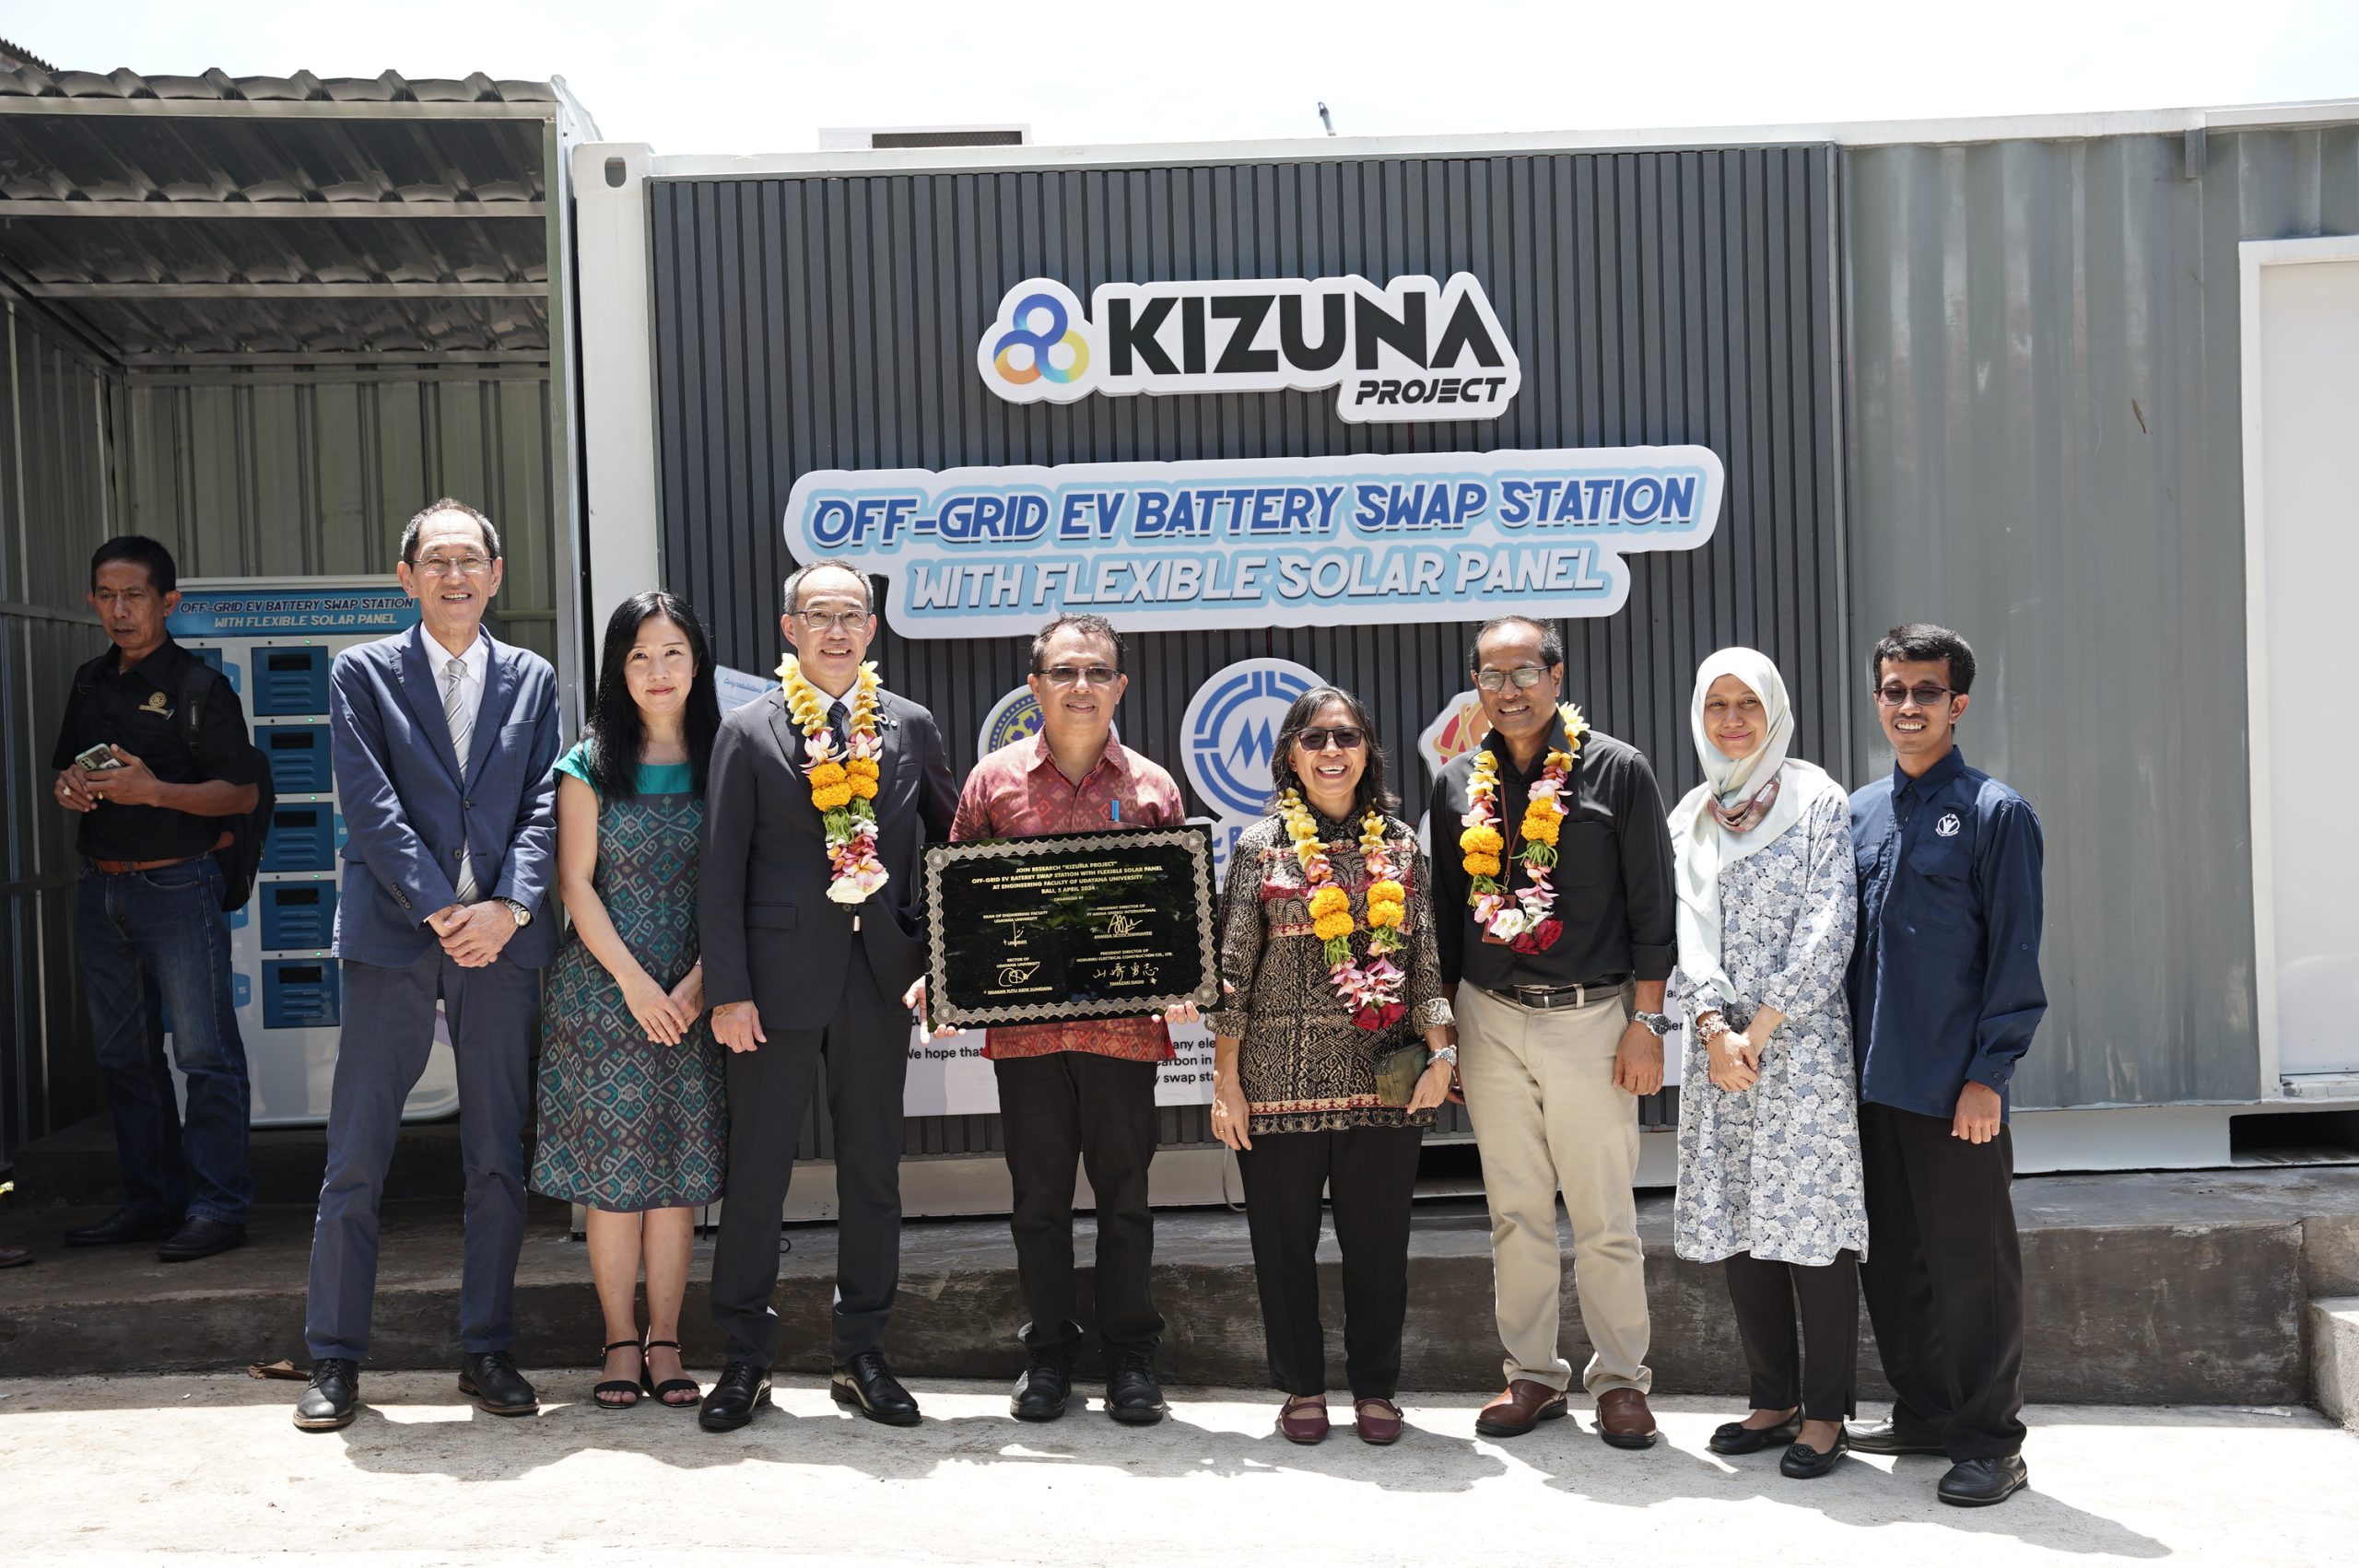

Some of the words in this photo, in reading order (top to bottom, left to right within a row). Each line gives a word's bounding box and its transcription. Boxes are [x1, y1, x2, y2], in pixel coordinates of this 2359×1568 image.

[1108, 288, 1506, 376] KIZUNA
[1355, 377, 1507, 405] PROJECT
[812, 494, 1050, 544] OFF-GRID
[1059, 492, 1126, 538] EV
[1134, 486, 1344, 535] BATTERY
[1355, 481, 1487, 531] SWAP
[1499, 476, 1696, 526] STATION
[912, 564, 1025, 609] WITH
[1032, 556, 1267, 605] FLEXIBLE
[1276, 552, 1445, 599] SOLAR
[1455, 547, 1605, 593] PANEL
[180, 602, 243, 614] OFF-GRID
[245, 601, 263, 613] EV
[264, 599, 322, 613] BATTERY
[323, 598, 358, 610] SWAP
[361, 597, 415, 609] STATION
[214, 616, 243, 628] WITH
[246, 615, 308, 627] FLEXIBLE
[311, 614, 356, 626] SOLAR
[358, 614, 397, 625] PANEL
[925, 1047, 957, 1060] hope
[959, 1047, 983, 1057] tha
[1202, 1054, 1212, 1065] in
[1163, 1074, 1196, 1084] swap
